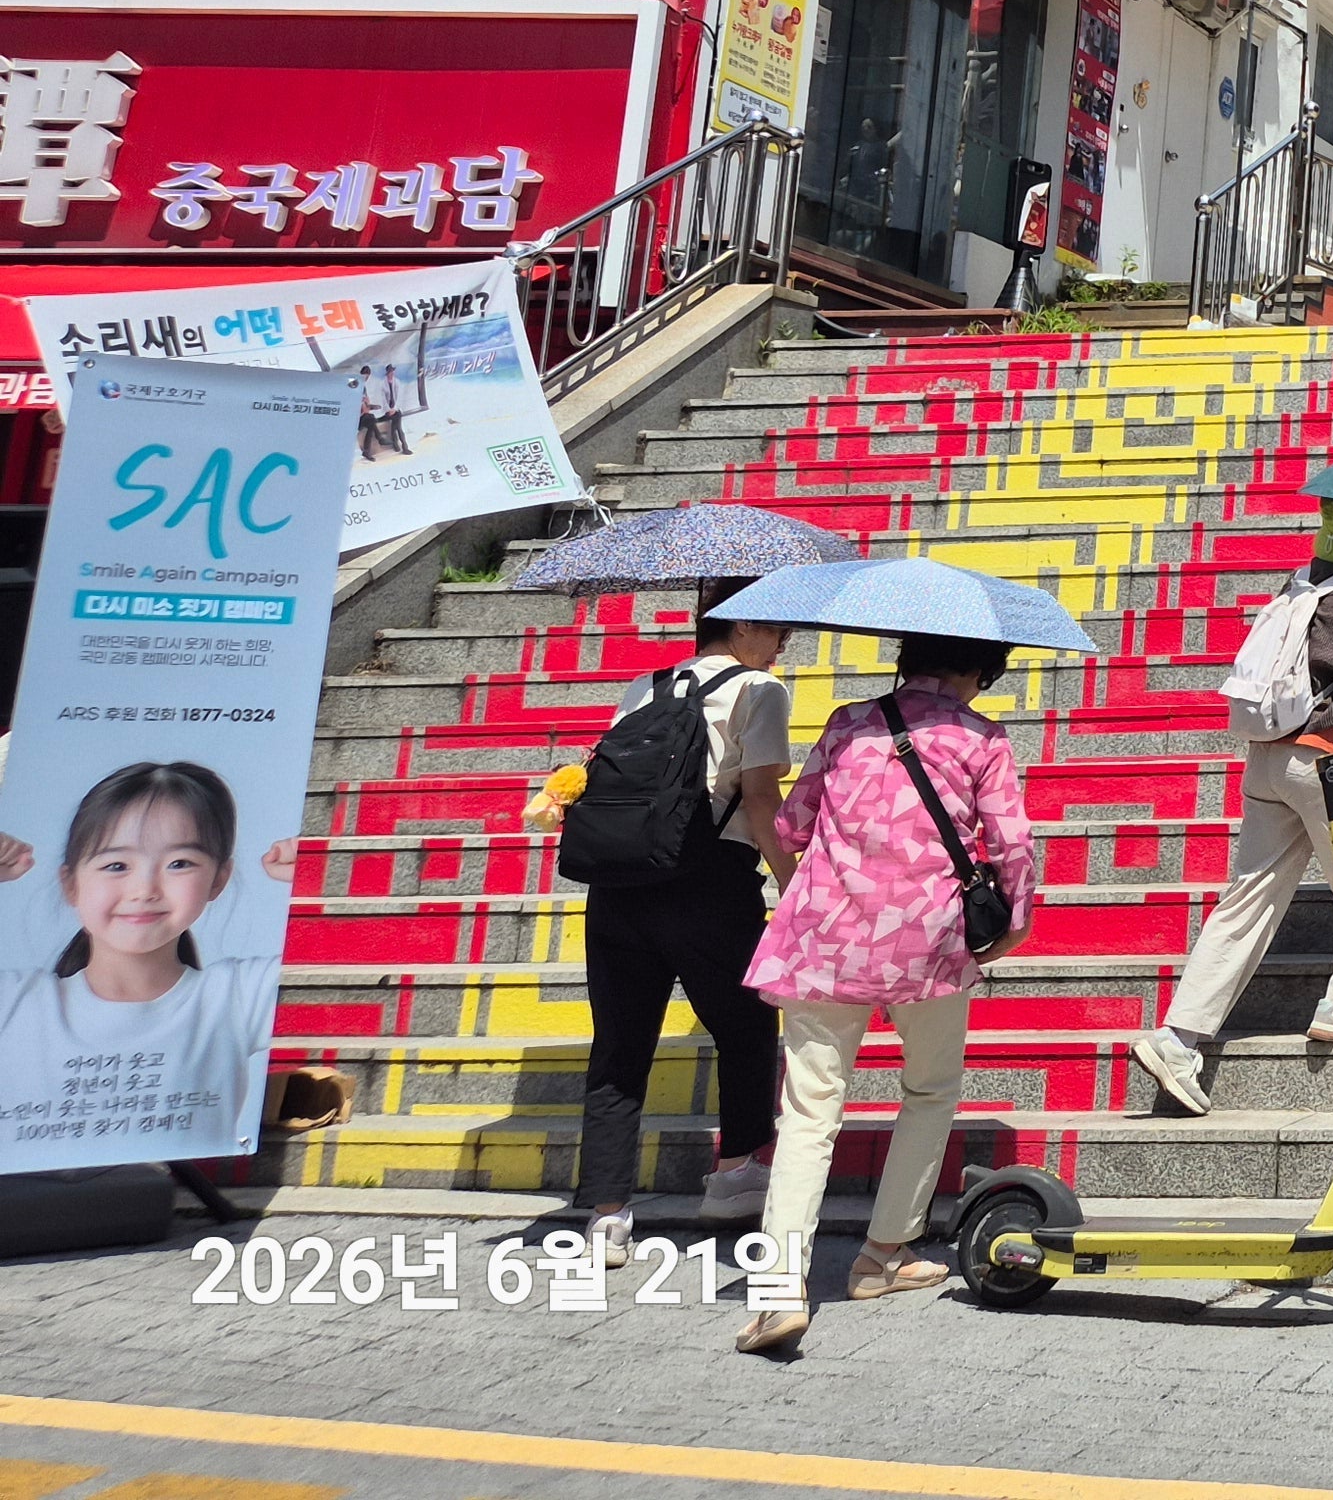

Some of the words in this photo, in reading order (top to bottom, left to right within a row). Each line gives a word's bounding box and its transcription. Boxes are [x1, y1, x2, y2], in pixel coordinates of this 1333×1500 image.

[150, 145, 544, 233] 중국제과담
[60, 315, 208, 357] 소리새의
[215, 306, 284, 346] 어떤
[294, 300, 366, 337] 노래
[372, 292, 490, 331] 좋아하세요?
[125, 384, 207, 400] 국제구호기구
[253, 401, 271, 411] 다시
[273, 403, 291, 412] 미소
[109, 443, 299, 559] SAC
[80, 562, 136, 579] Smile
[139, 564, 197, 583] Again
[201, 567, 299, 587] Campaign
[85, 596, 128, 615] 다시
[132, 597, 174, 616] 미소
[177, 599, 219, 618] 짓기
[223, 600, 285, 619] 캠페인
[155, 636, 182, 650] 다시
[184, 637, 212, 651] 웃게
[216, 638, 241, 651] 하는
[80, 650, 107, 664] 국민
[141, 652, 196, 666] 캠페인의
[200, 653, 269, 667] 시작입니다.
[58, 707, 99, 721] ARS
[105, 707, 138, 722] 후원
[143, 707, 177, 722] 전화
[181, 708, 276, 722] 1877-0324
[64, 1054, 123, 1074] 아이가
[128, 1052, 165, 1070] 웃고
[62, 1075, 118, 1096] 청년이
[124, 1073, 162, 1091] 웃고
[59, 1098, 96, 1117] 웃는
[103, 1094, 159, 1114] 나라를
[165, 1091, 221, 1110] 만드는
[15, 1119, 87, 1142] 100만명
[138, 1112, 193, 1133] 캠페인
